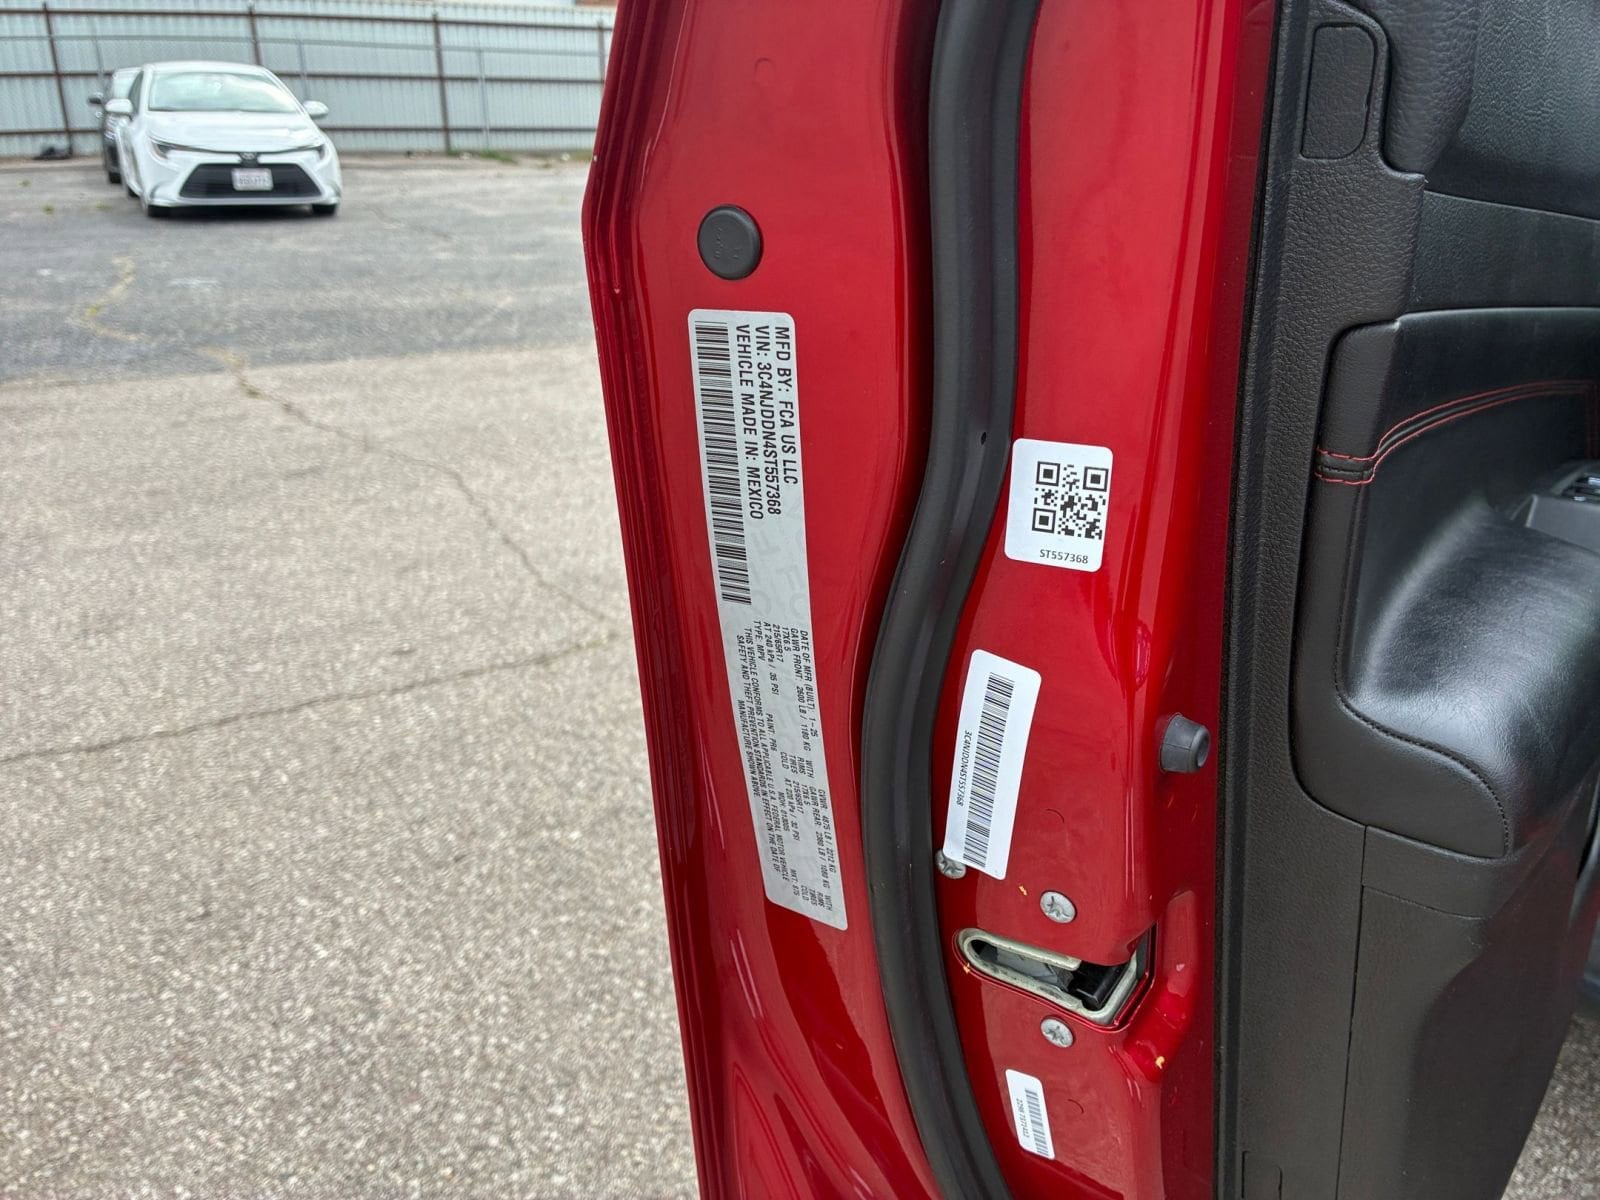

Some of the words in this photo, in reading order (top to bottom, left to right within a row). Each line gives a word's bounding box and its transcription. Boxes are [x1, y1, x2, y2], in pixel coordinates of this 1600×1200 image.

[756, 326, 770, 356] VIN:
[775, 326, 790, 360] MFD
[736, 325, 753, 386] VEHICLE
[778, 368, 792, 392] BY:
[742, 393, 757, 435] MADE
[780, 401, 794, 428] FCA
[745, 441, 759, 460] IN:
[758, 362, 781, 515] 3C4NJDDN4ST557368
[782, 435, 796, 454] US
[783, 460, 798, 484] LLC
[747, 466, 763, 519] MEXICO
[1040, 549, 1088, 564] ST557368
[744, 628, 753, 644] THIS
[764, 622, 771, 632] AT
[737, 635, 746, 662] SAFETY
[800, 630, 809, 652] DATE
[747, 646, 757, 675] VEHICLE
[803, 653, 810, 663] OF
[804, 665, 812, 681] MFR
[744, 682, 752, 704] THEFT
[751, 677, 762, 716] CONFORMS
[791, 628, 800, 651] GAWR
[799, 705, 806, 714] LB
[804, 741, 810, 751] KG
[747, 706, 759, 748] PREVENTION
[757, 718, 764, 727] TO
[738, 700, 751, 749] MANUFACTURE
[746, 751, 756, 775] SHOWN
[754, 749, 766, 788] STANDARDS
[761, 743, 773, 781] APPLICABLE
[784, 778, 791, 786] AT
[809, 786, 818, 806] GAWR
[762, 798, 772, 821] EFFECT
[771, 804, 781, 832] FEDERAL
[766, 822, 773, 832] ON
[776, 834, 785, 855] MOTOR
[774, 864, 780, 872] OF
[780, 856, 789, 881] VEHICLE
[829, 864, 836, 873] KG
